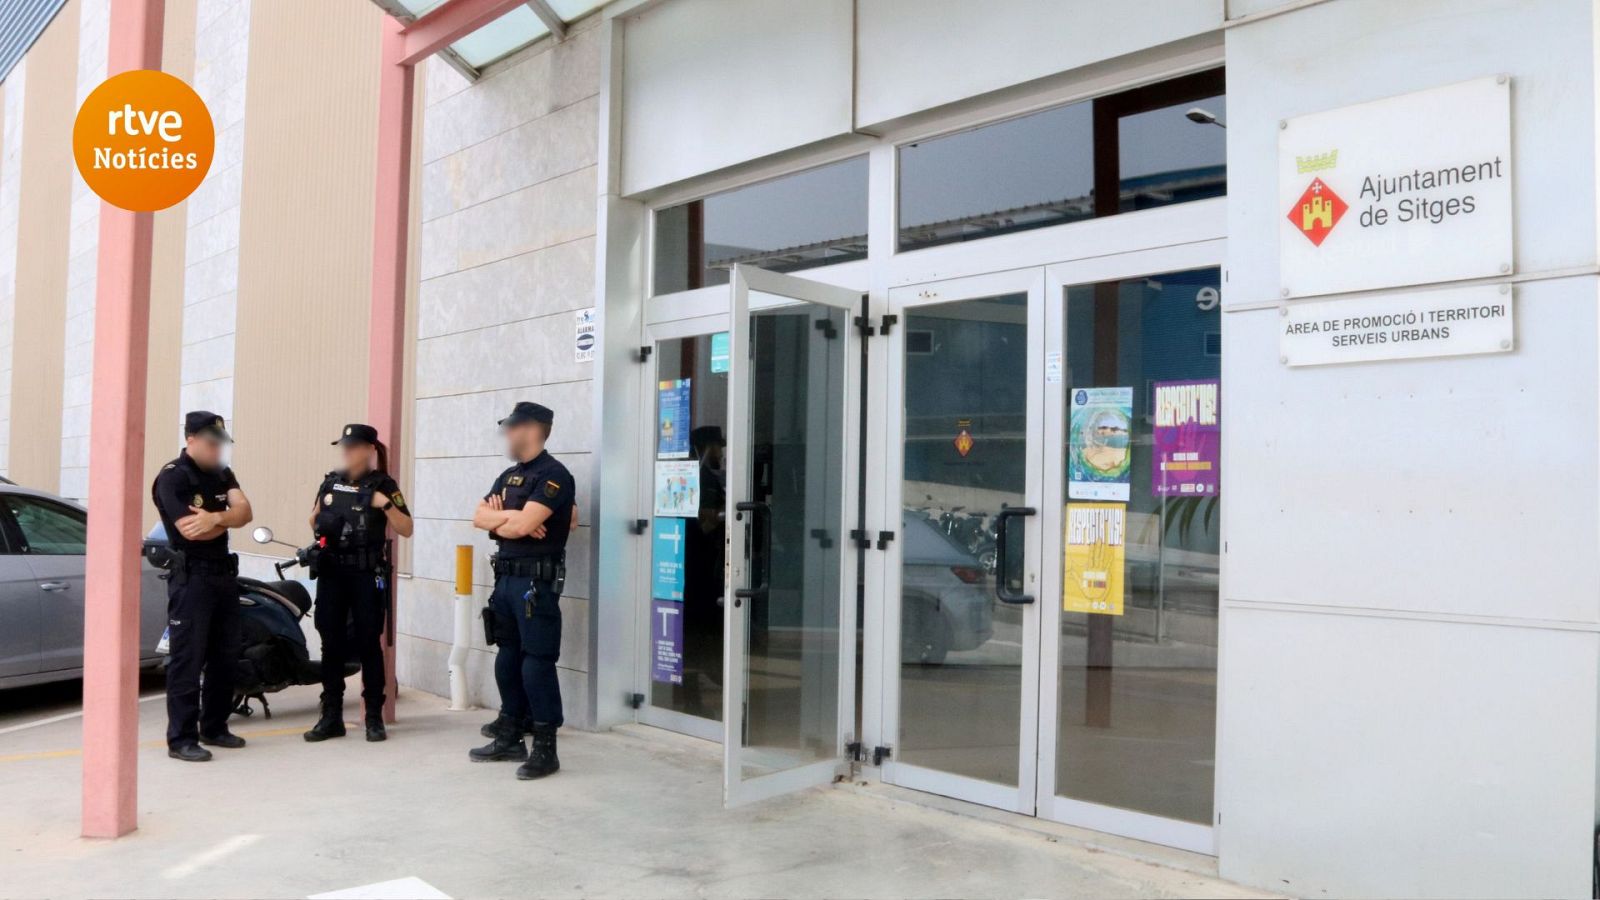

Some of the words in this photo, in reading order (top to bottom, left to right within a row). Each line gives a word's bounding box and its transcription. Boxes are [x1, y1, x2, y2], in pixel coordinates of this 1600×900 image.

[1359, 156, 1502, 202] Ajuntament
[1359, 205, 1388, 228] de
[1397, 195, 1476, 224] Sitges
[1285, 321, 1320, 335] ÀREA
[1323, 320, 1340, 332] DE
[1343, 309, 1417, 329] PROMOCIÓ
[1428, 304, 1506, 324] TERRITORI
[1332, 332, 1387, 347] SERVEIS
[1391, 326, 1451, 342] URBANS
